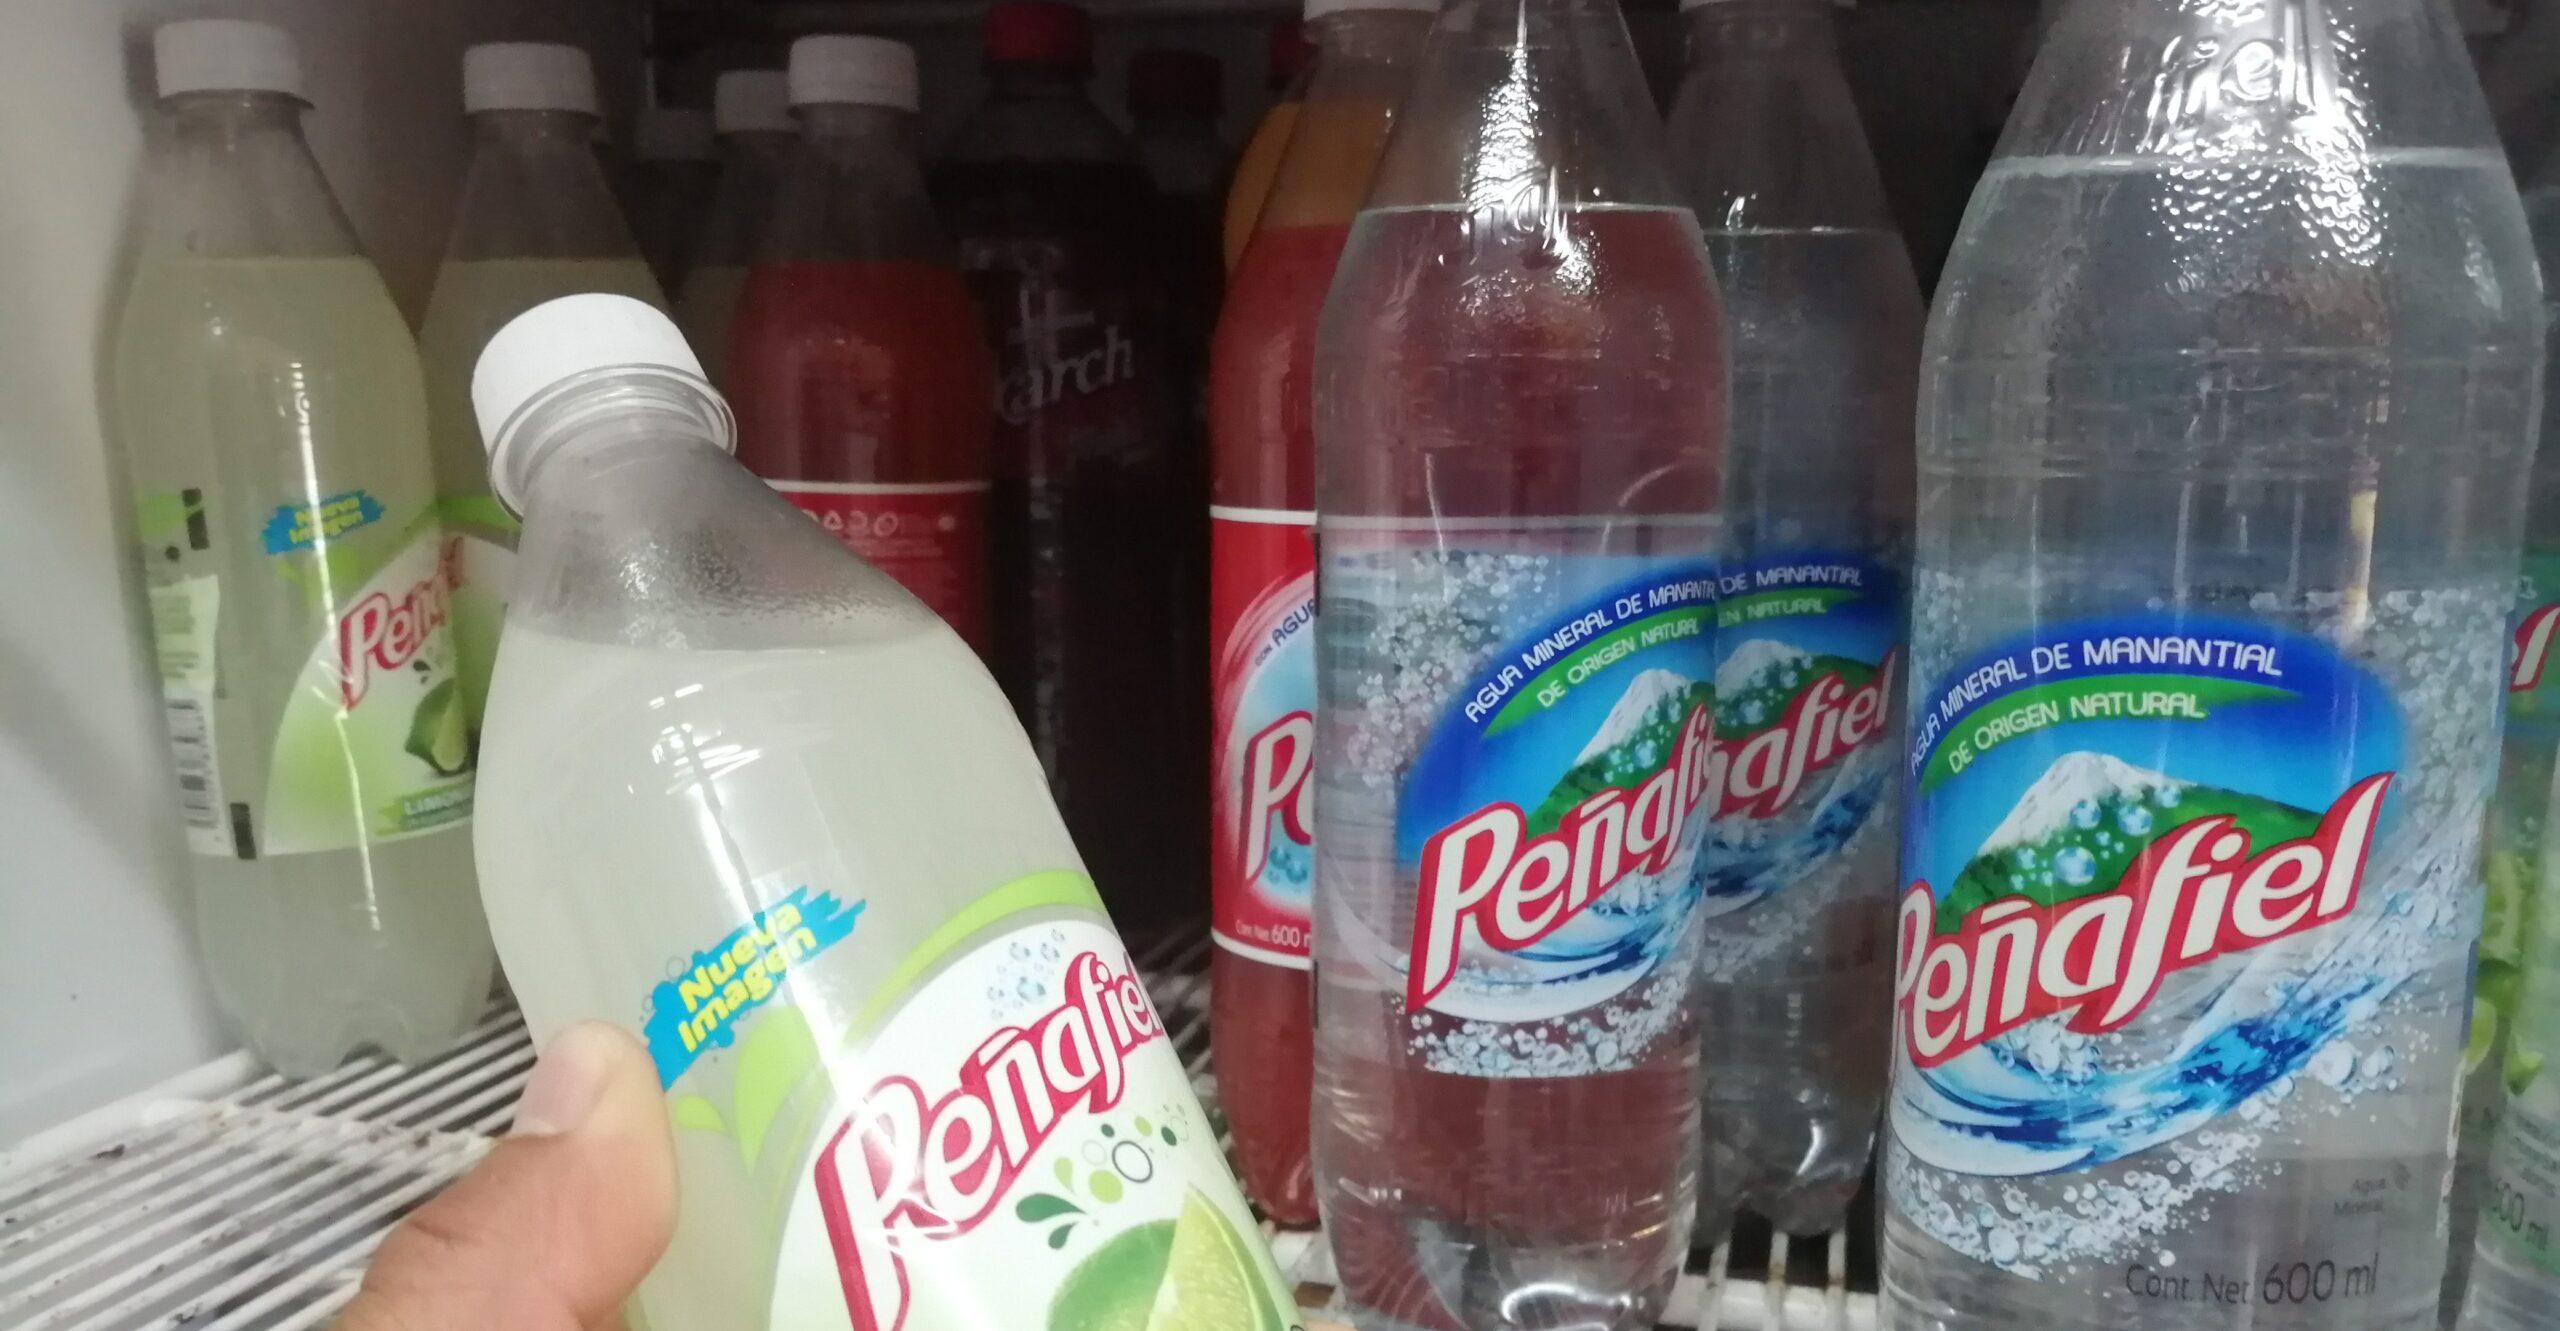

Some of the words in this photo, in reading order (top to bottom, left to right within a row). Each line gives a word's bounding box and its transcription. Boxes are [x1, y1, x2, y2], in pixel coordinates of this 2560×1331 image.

[1719, 573, 1749, 595] DE
[1755, 564, 1863, 588] MANANTIAL
[1746, 597, 1828, 619] NATURAL
[1464, 664, 1524, 723] AGUA
[1521, 608, 1614, 672] MINERAL
[1615, 592, 1644, 620] DE
[1536, 679, 1567, 708] DE
[1566, 635, 1637, 685] ORIGEN
[1640, 617, 1700, 648] NATURAL
[1910, 711, 1942, 777] AGUA
[1940, 656, 2028, 722] MINERAL
[2030, 642, 2073, 675] DE
[2082, 635, 2284, 678] MANANTIAL
[1948, 740, 1974, 775] DE
[1974, 699, 2061, 751] ORIGEN
[2069, 690, 2207, 720] NATURAL
[678, 902, 803, 1013] Nueva
[1271, 924, 1301, 948] 600
[677, 926, 818, 1053] Imagen
[2262, 1258, 2337, 1305] 600
[2344, 1251, 2380, 1298] ml
